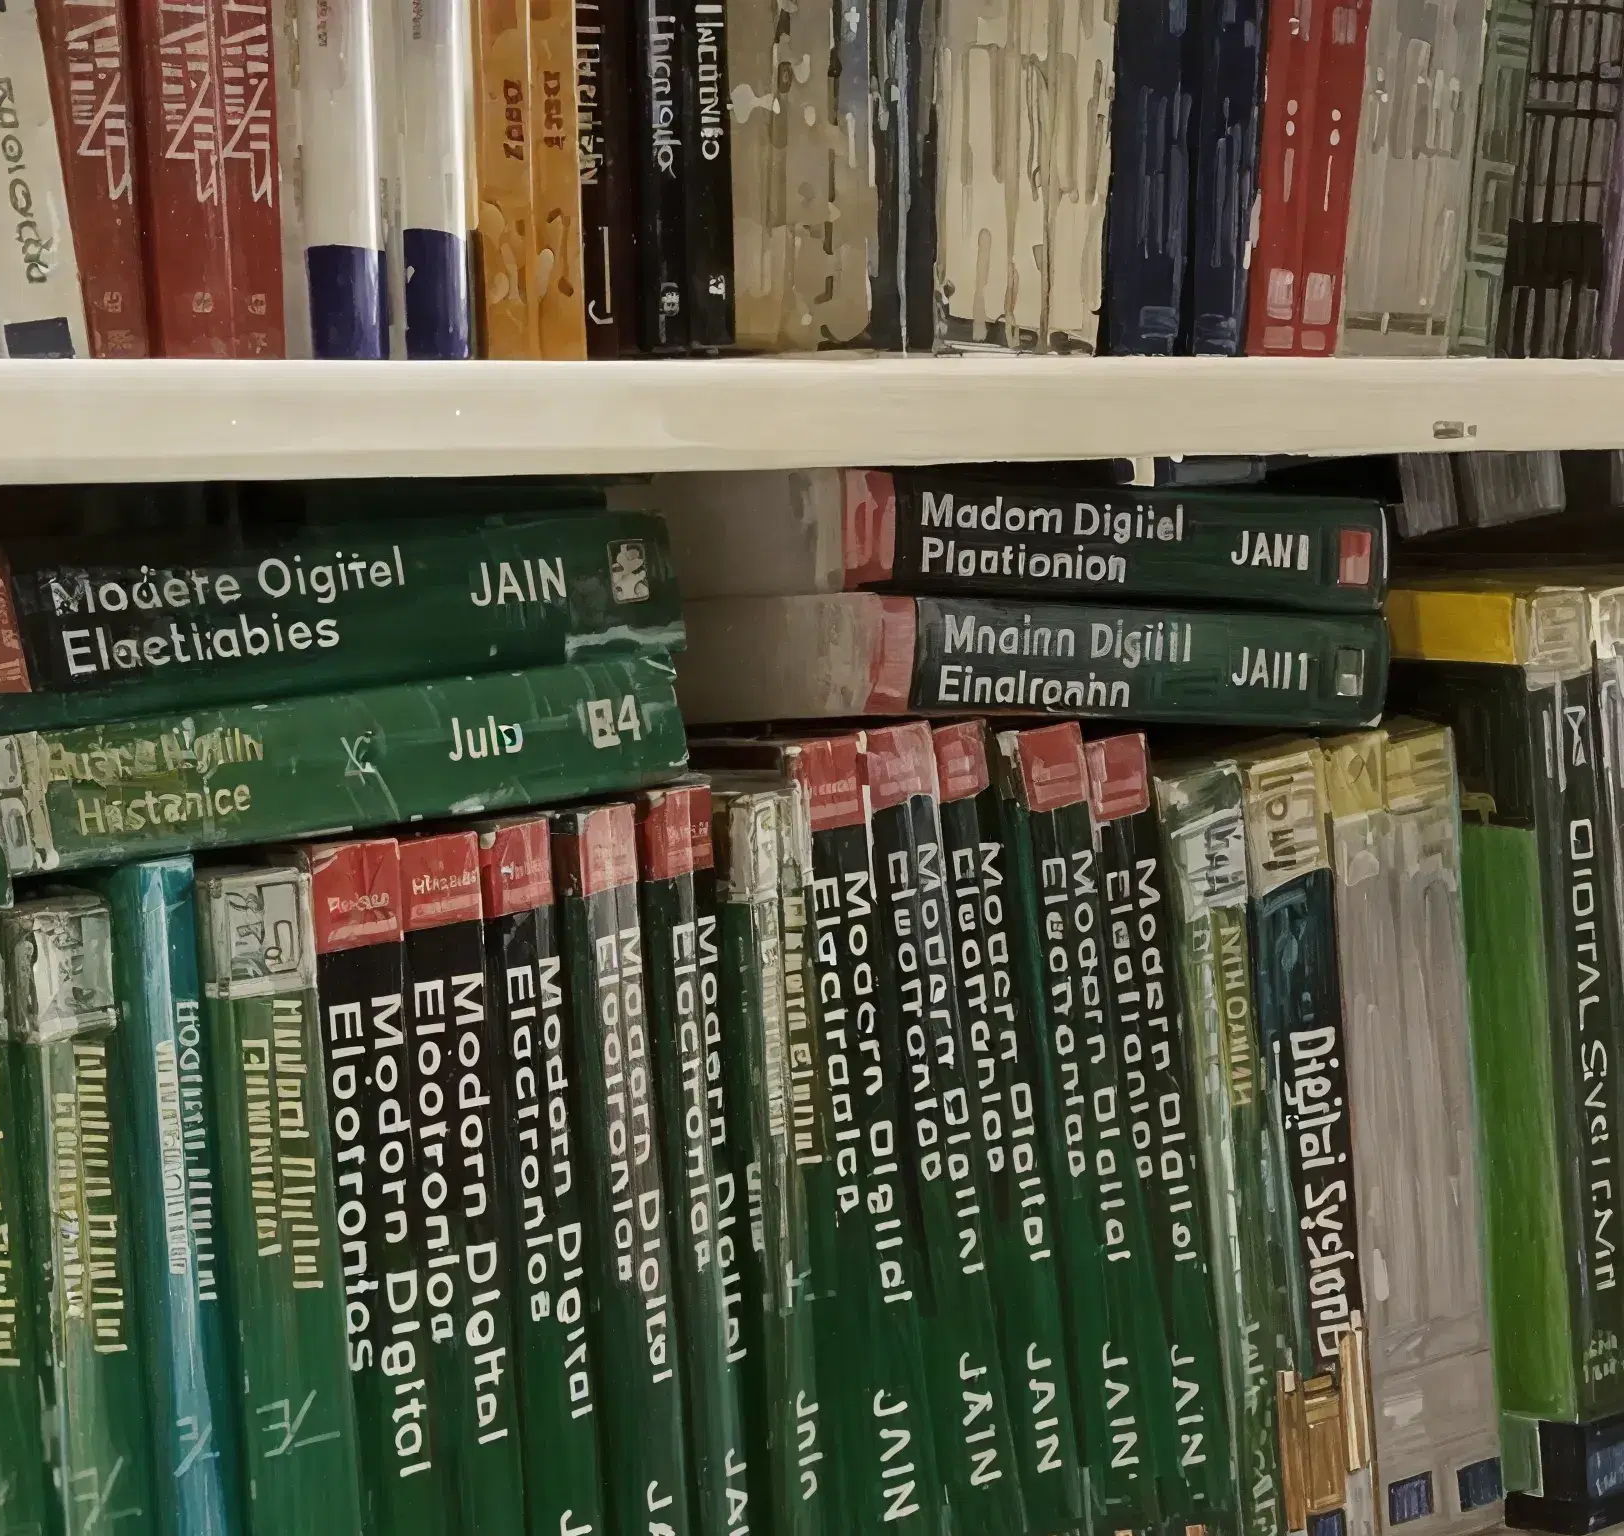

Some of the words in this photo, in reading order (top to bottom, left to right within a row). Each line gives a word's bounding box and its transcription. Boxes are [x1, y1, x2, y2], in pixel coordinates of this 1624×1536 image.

[470, 556, 568, 607] JAIN
[872, 1388, 921, 1523] JAIN
[958, 1351, 1003, 1488] JAIN
[1026, 1340, 1063, 1475] JAIN
[1101, 1340, 1140, 1470] JAIN
[1169, 1343, 1209, 1468] JAIN
